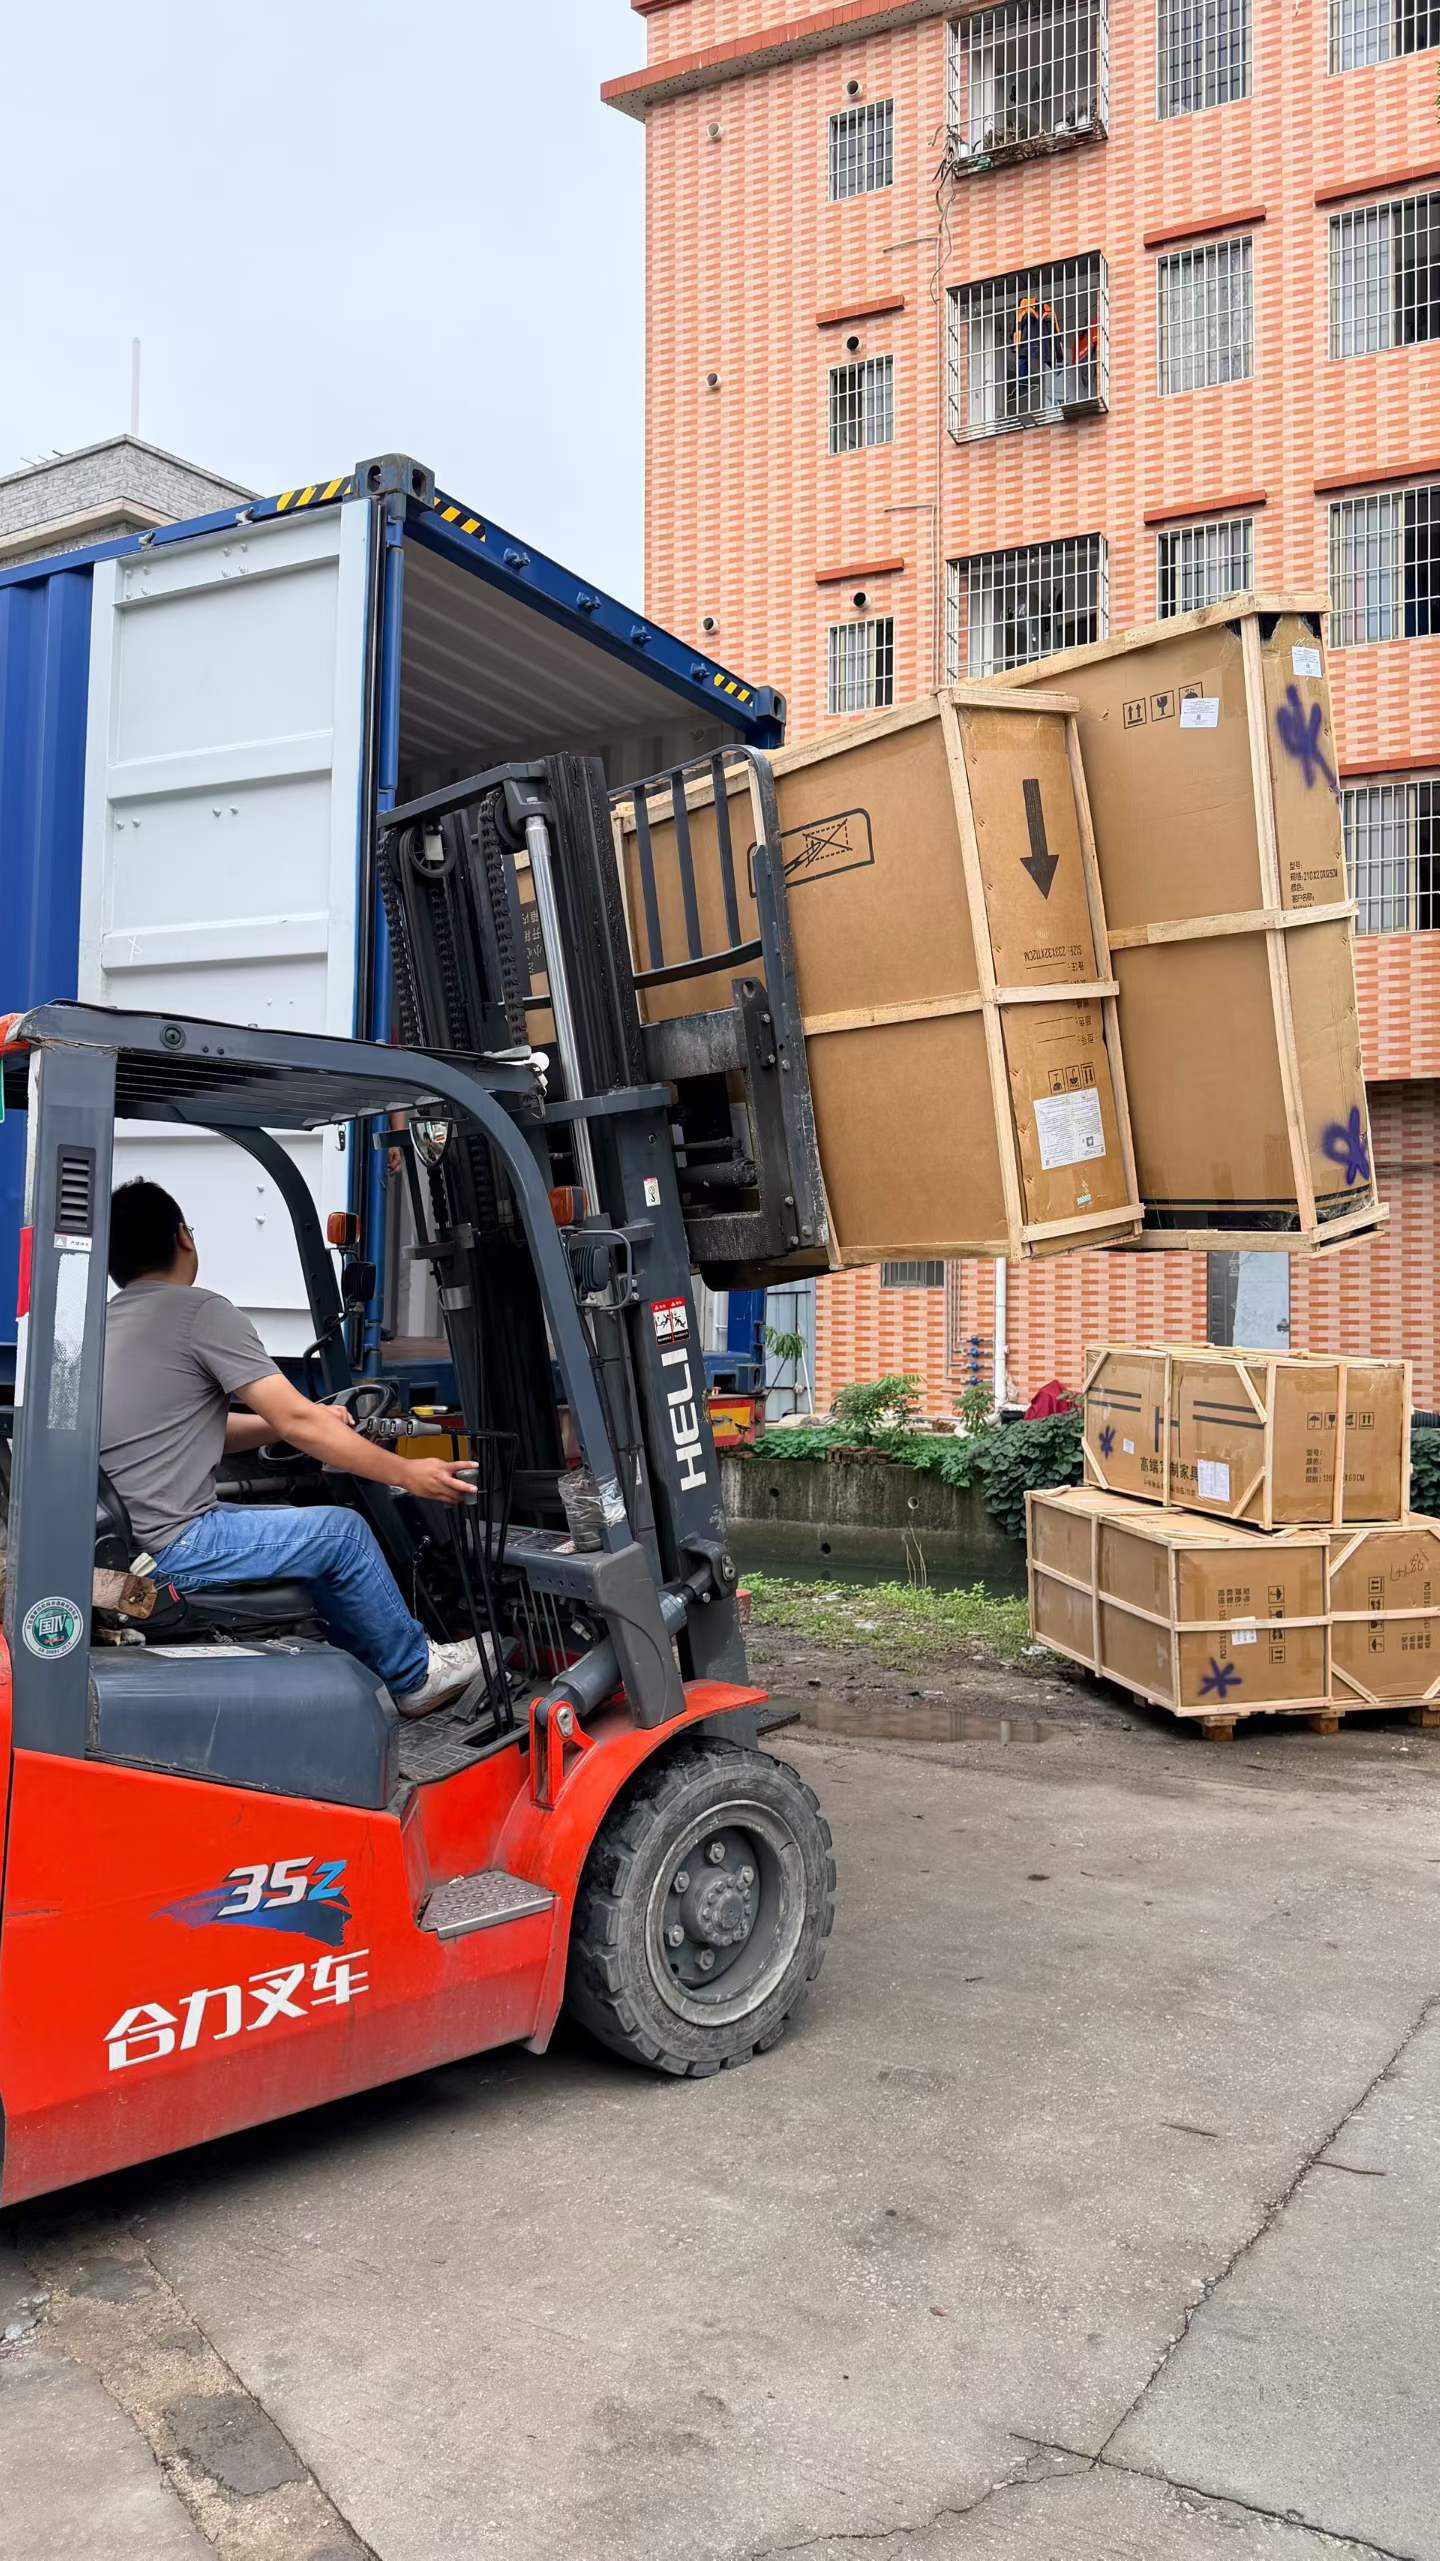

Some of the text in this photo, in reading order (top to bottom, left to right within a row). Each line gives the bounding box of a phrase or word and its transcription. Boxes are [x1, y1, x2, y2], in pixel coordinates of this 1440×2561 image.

[661, 1347, 707, 1491] HELI
[103, 1949, 369, 2071] 合力叉车
